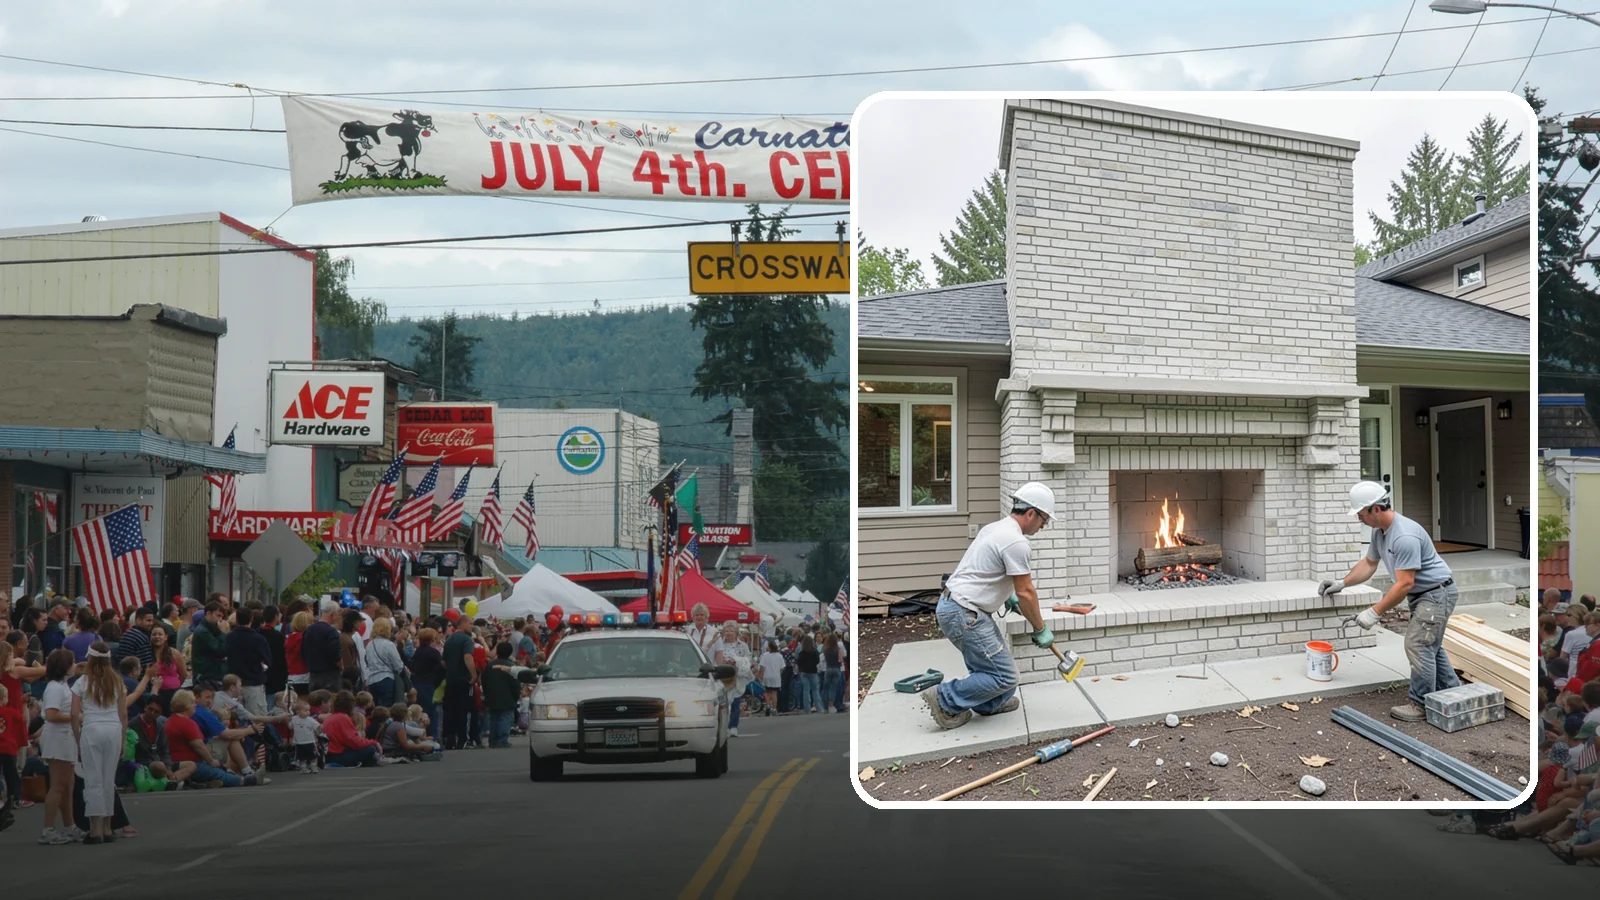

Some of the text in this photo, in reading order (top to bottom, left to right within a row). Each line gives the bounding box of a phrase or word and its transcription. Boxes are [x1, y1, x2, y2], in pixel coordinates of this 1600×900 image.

[695, 121, 850, 149] Carnat
[481, 141, 605, 192] JULY
[632, 150, 746, 197] 4th.
[697, 254, 850, 280] CROSSWA
[283, 380, 374, 420] ACE
[406, 410, 452, 422] CEDAR
[283, 421, 370, 436] Hardware
[416, 428, 476, 446] Coca-Cola
[95, 485, 124, 495] Vincent
[126, 486, 136, 495] de
[137, 486, 155, 495] Paul
[688, 526, 742, 535] CRNATION
[699, 535, 730, 543] GLASS
